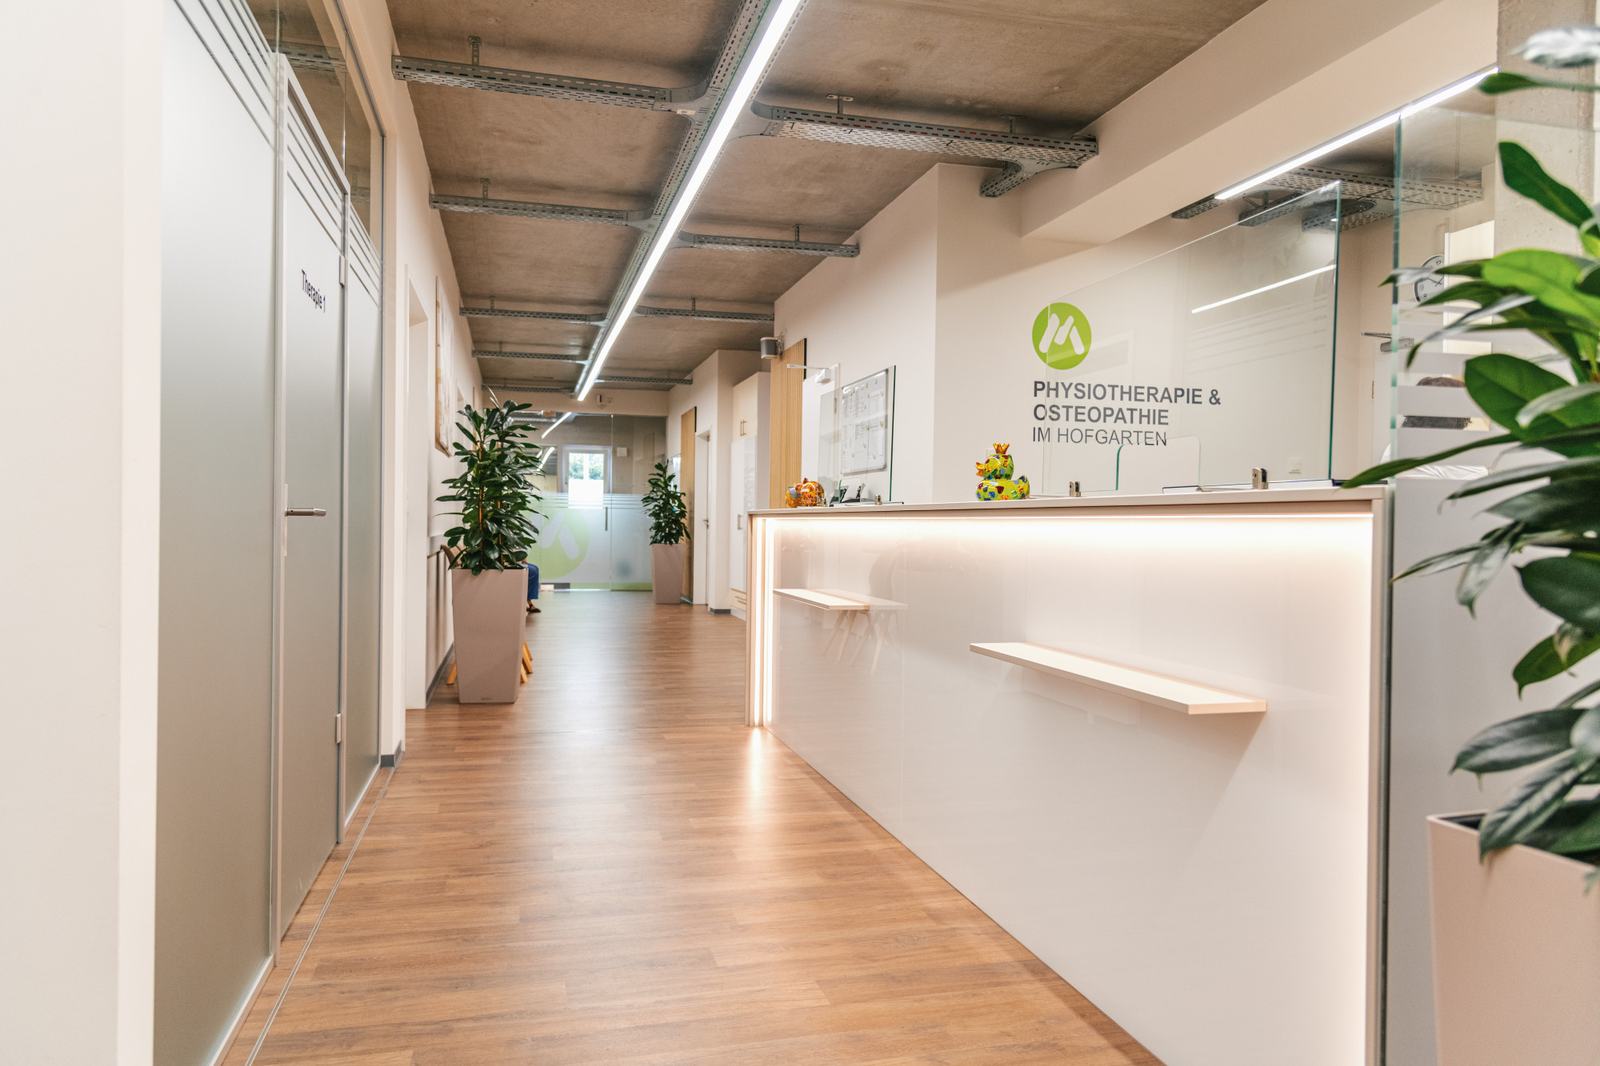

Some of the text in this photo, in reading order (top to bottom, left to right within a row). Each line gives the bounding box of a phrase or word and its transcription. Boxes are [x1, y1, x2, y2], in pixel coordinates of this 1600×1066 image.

[301, 269, 322, 310] Therapie
[1034, 381, 1221, 405] PHYSIOTHERAPIE &
[1033, 404, 1169, 425] OSTEOPATHIE
[1032, 427, 1167, 446] IM HOFGARTEN
